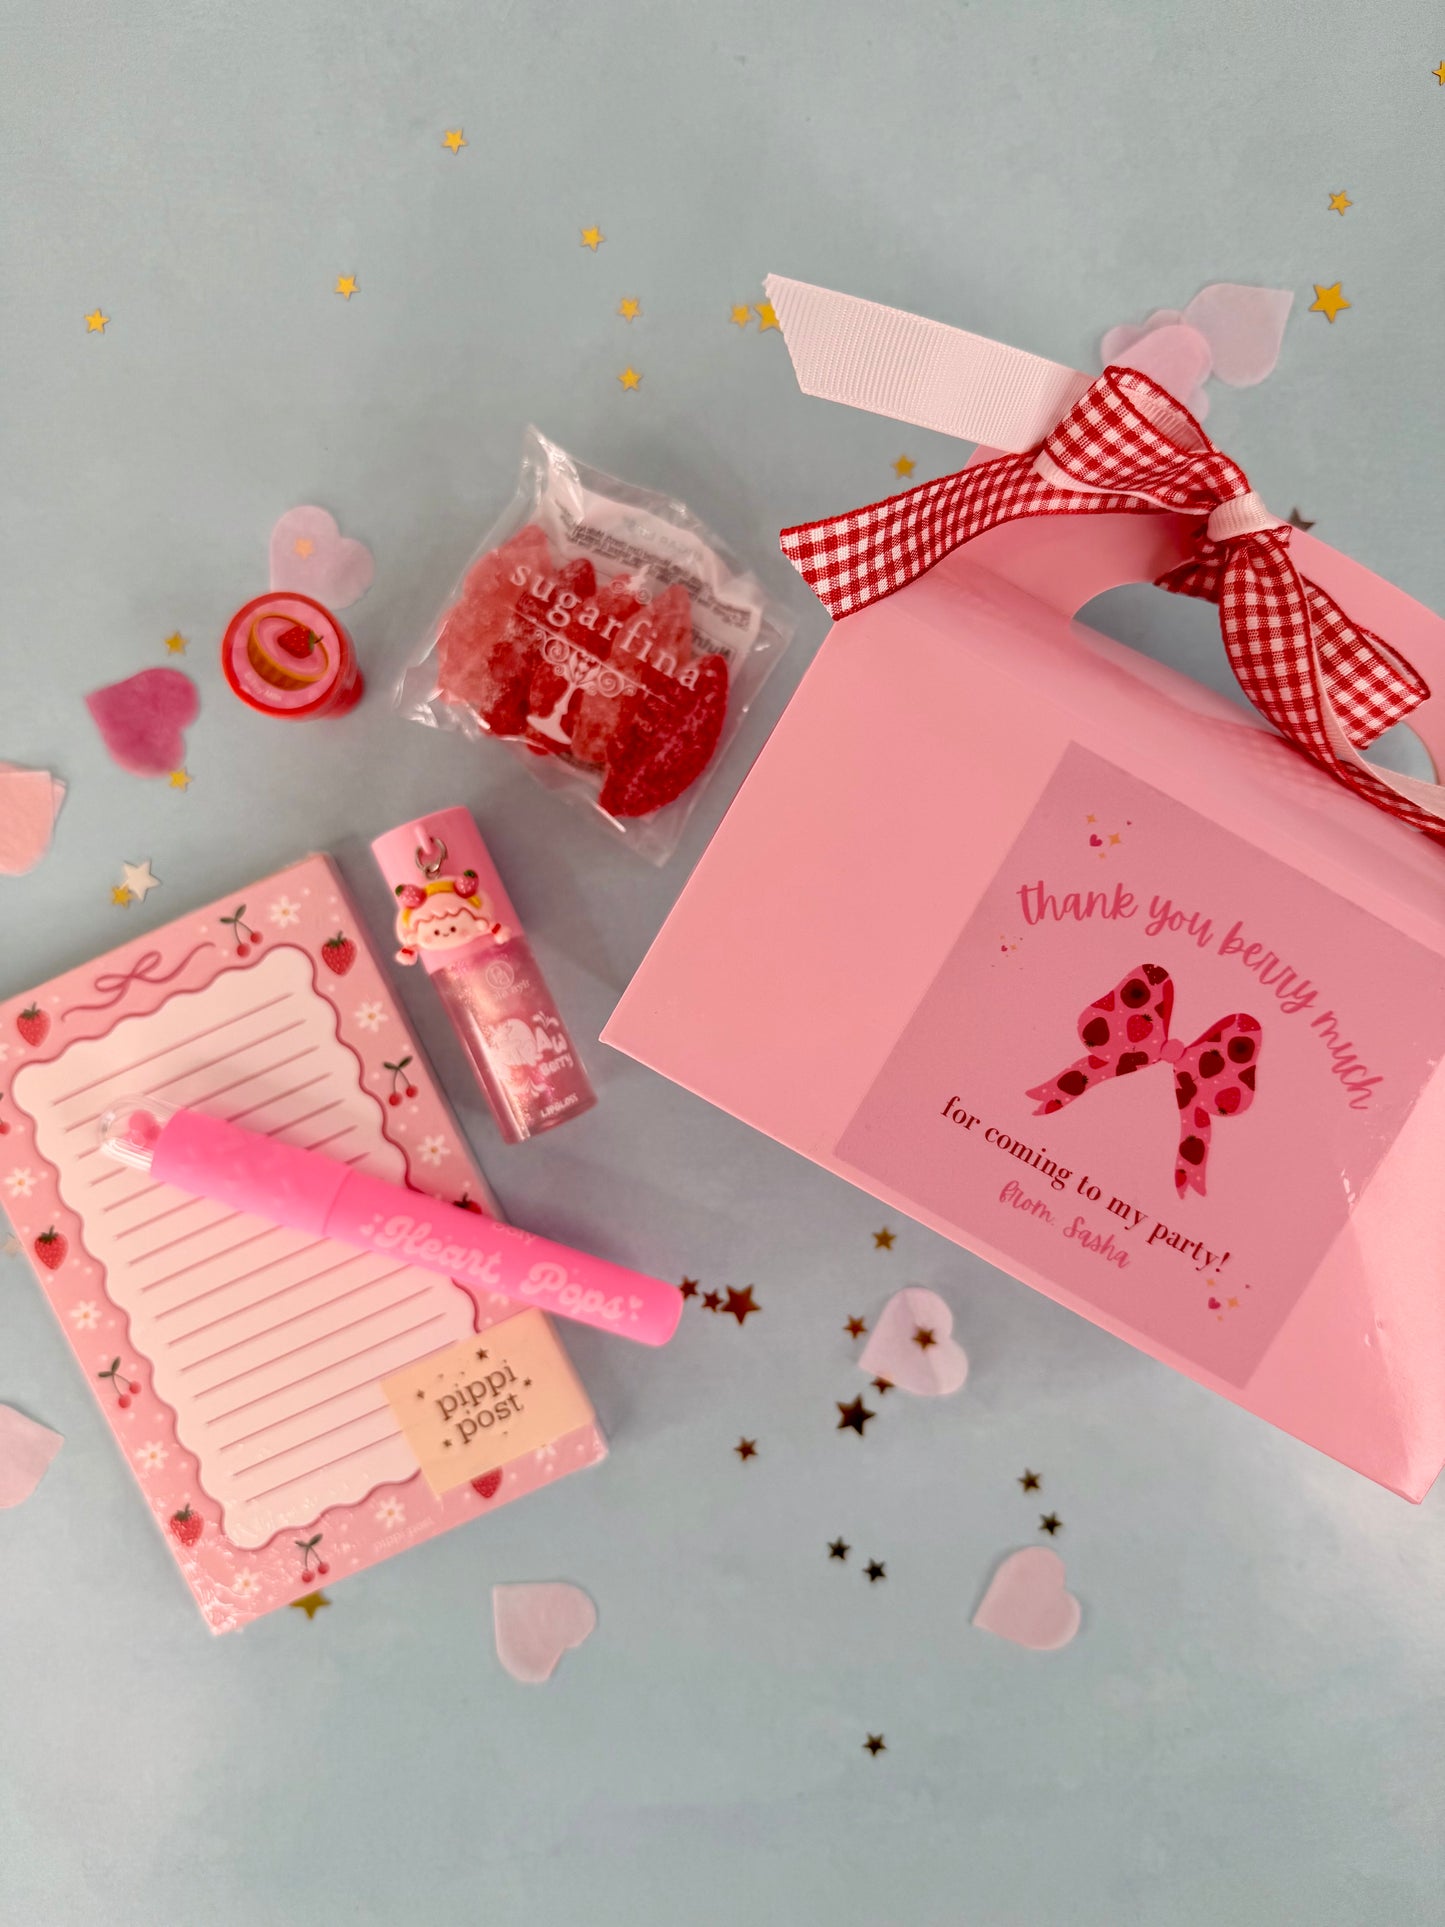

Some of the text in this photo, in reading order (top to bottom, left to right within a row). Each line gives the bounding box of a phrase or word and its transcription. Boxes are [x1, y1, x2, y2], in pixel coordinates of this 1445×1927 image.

[510, 565, 700, 692] sugarfina
[1016, 880, 1384, 1110] thank you berry much
[940, 1095, 1231, 1273] for coming to my party!
[374, 1215, 626, 1319] Heart Pops
[1062, 1216, 1132, 1269] Sasha
[435, 1359, 518, 1421] pippi
[455, 1393, 525, 1445] post
